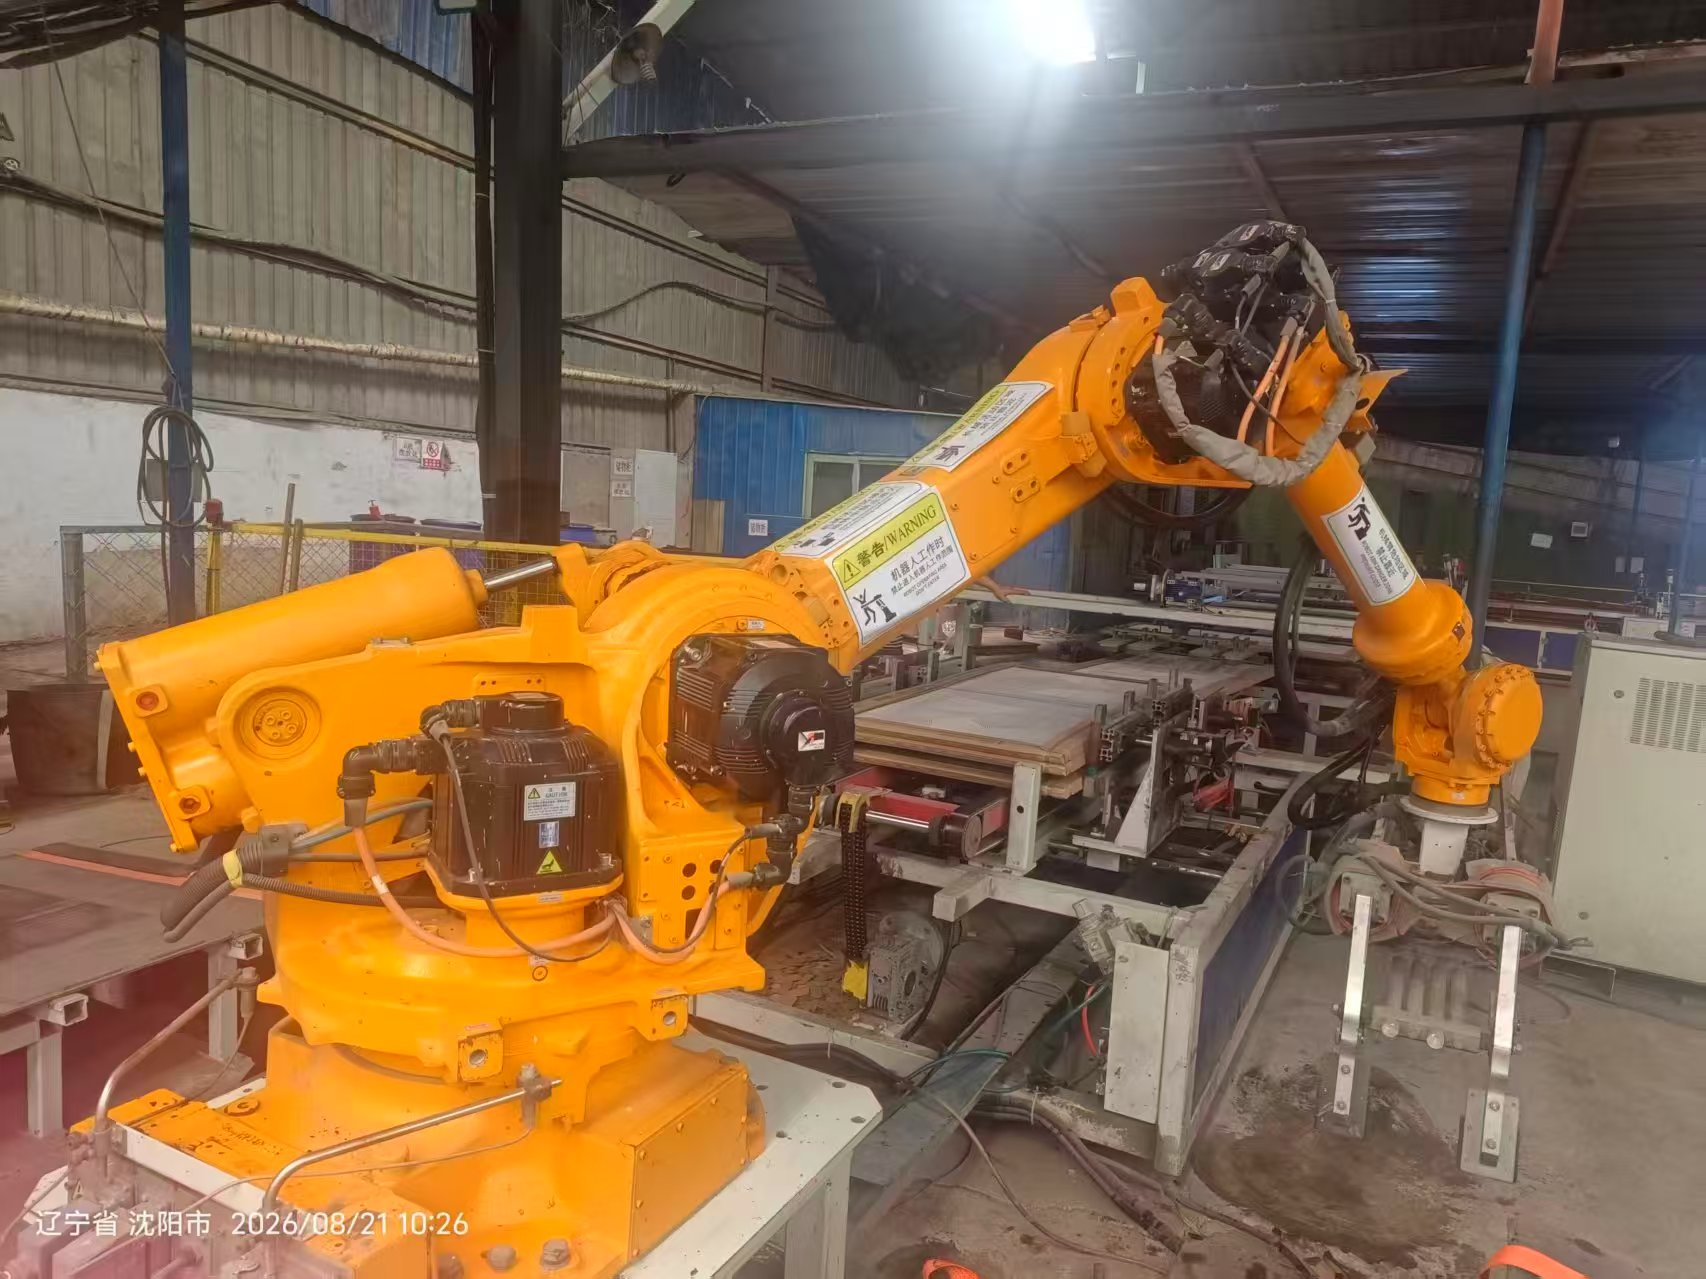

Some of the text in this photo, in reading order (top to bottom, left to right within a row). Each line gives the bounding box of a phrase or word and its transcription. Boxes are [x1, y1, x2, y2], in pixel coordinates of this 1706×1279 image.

[890, 536, 945, 582] 机器人工作时
